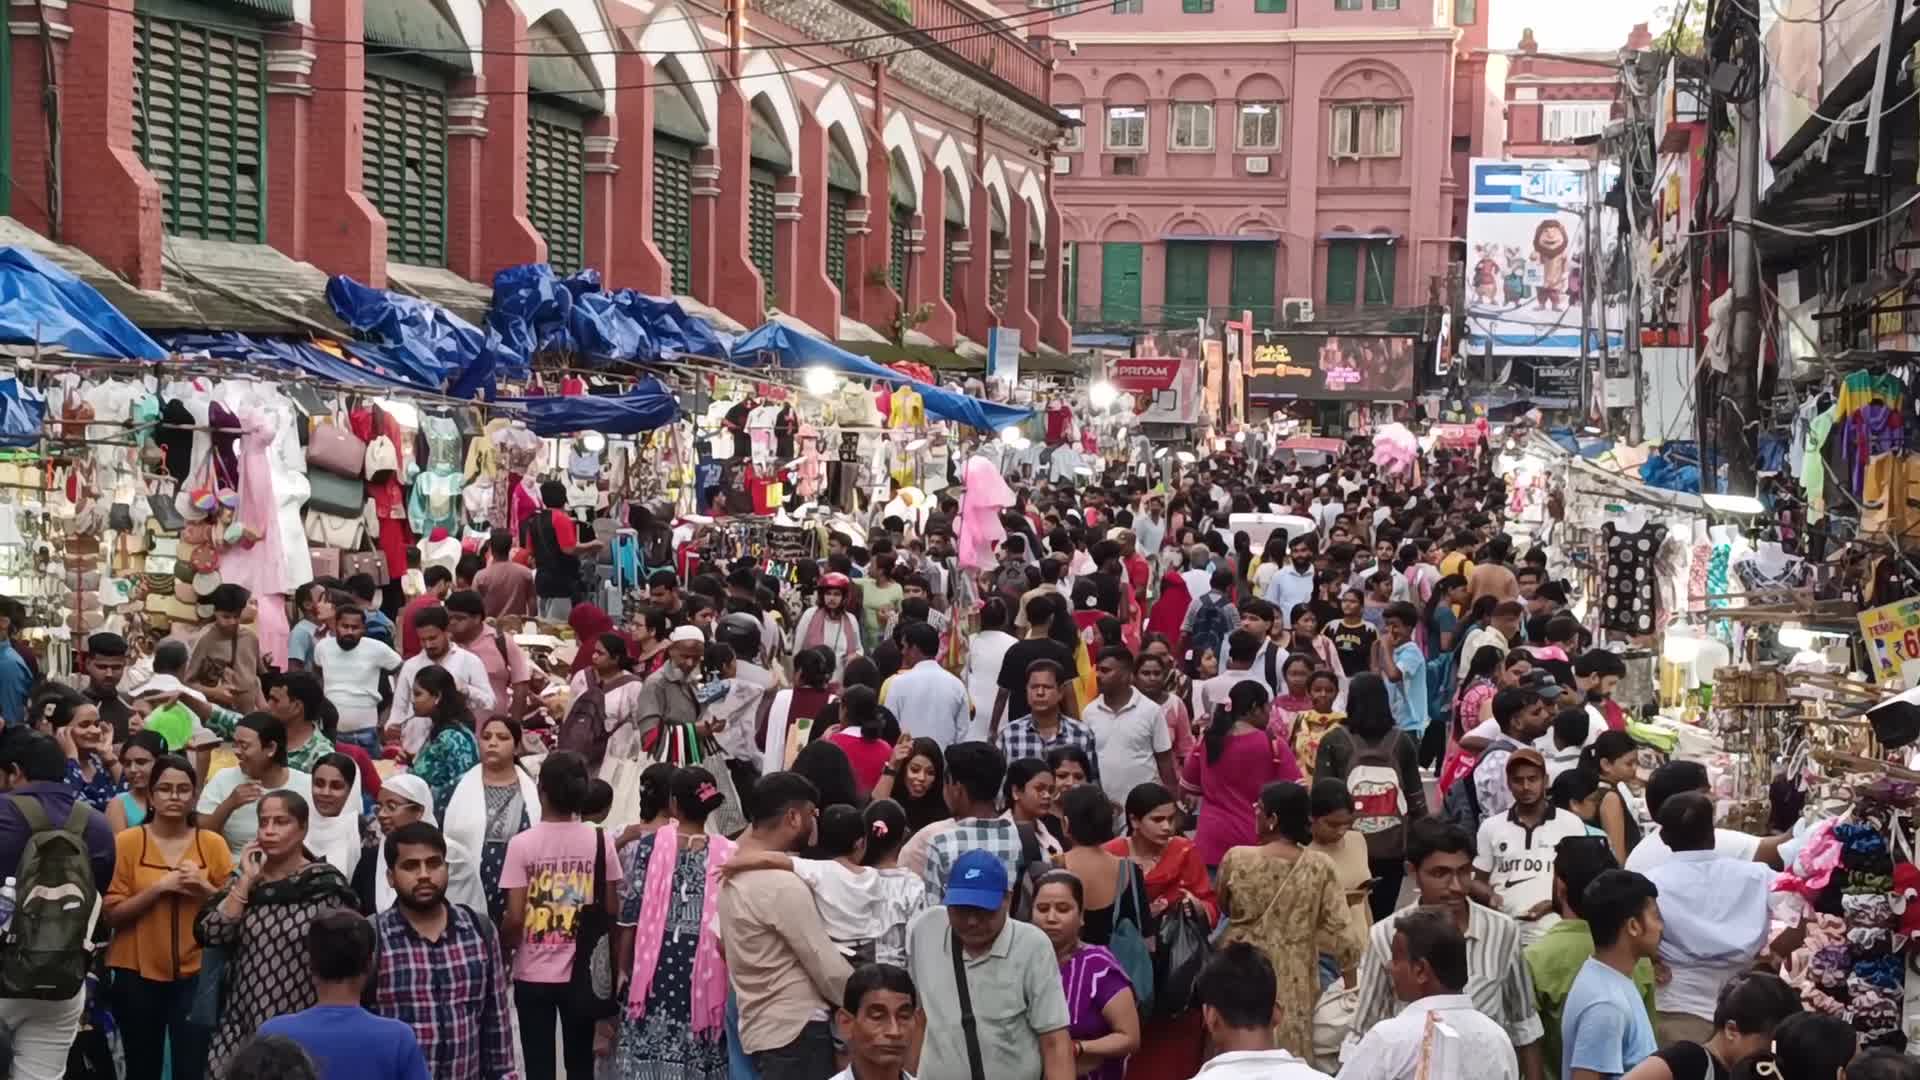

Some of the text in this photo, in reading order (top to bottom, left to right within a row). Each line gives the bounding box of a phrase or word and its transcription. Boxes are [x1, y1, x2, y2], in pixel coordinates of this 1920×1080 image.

[1119, 366, 1168, 377] PRITAM
[561, 860, 596, 875] BEAC
[1524, 859, 1543, 872] DO
